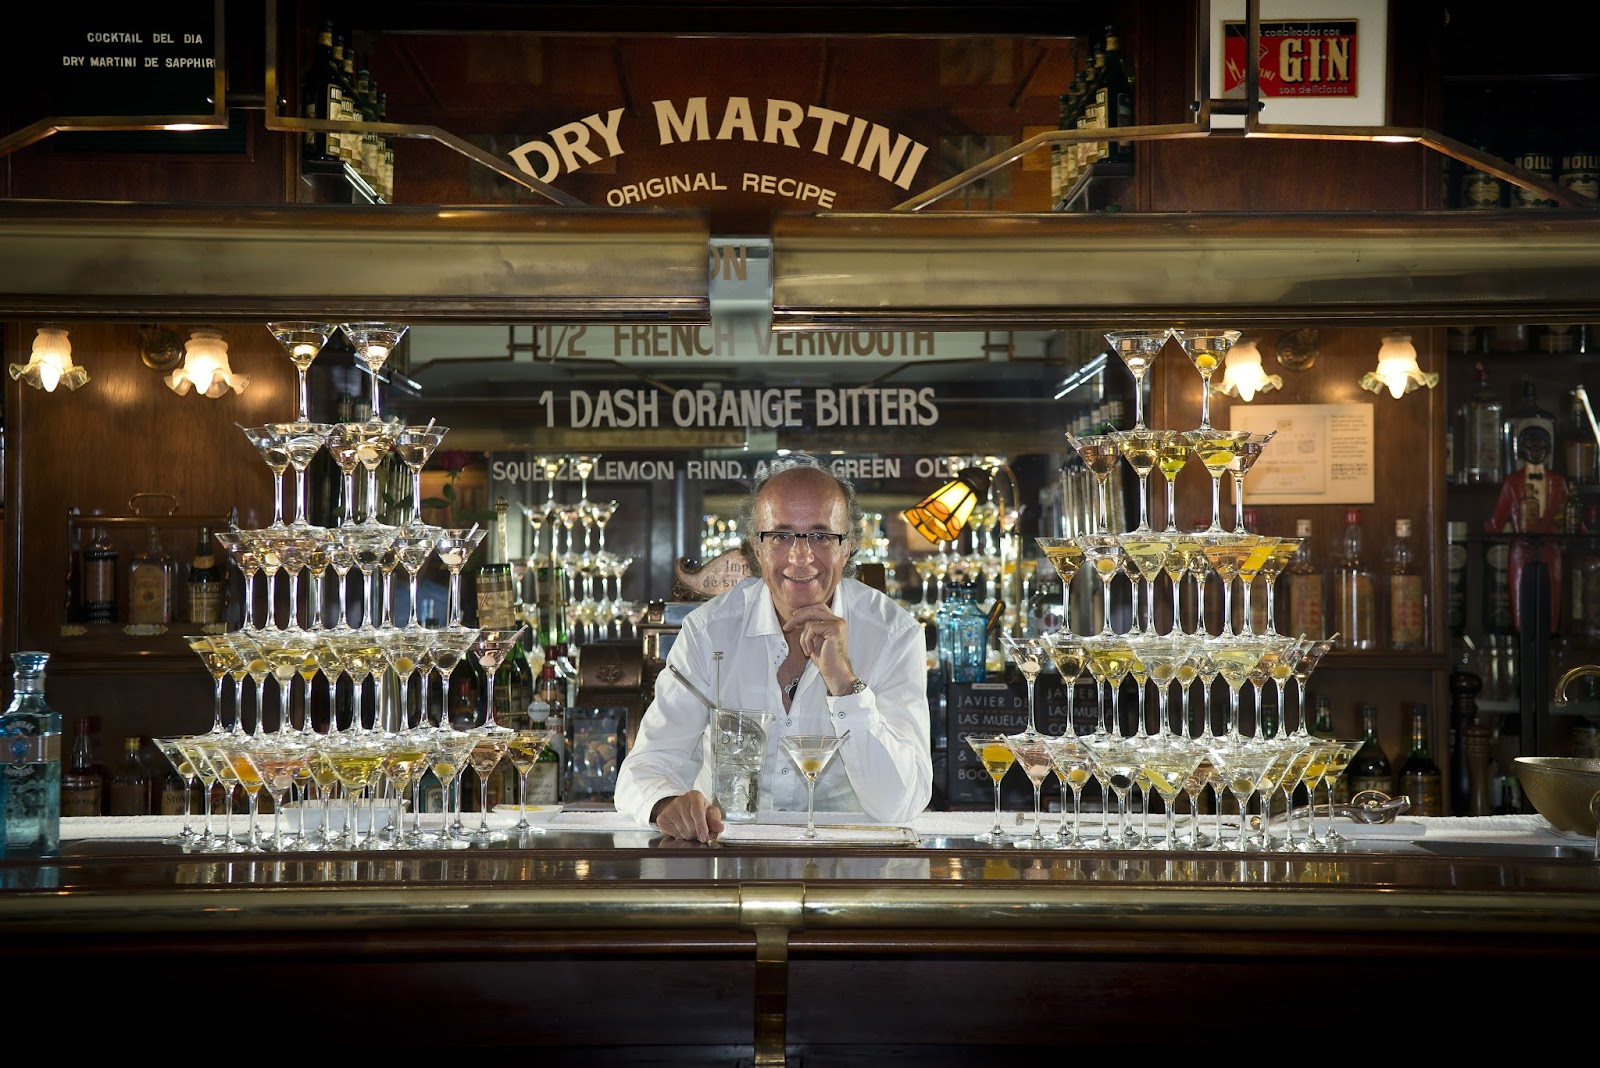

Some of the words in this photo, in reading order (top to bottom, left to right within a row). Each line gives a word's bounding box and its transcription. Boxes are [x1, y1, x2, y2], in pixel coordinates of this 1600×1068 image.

[87, 32, 143, 43] COCKTAIL
[152, 33, 175, 44] DEL
[183, 33, 204, 44] DIA
[62, 55, 85, 67] DRY
[90, 56, 137, 68] MARTINI
[144, 57, 159, 68] DE
[508, 107, 626, 192] DRY
[652, 95, 929, 191] MARTINI
[606, 172, 727, 207] ORIGINAL
[742, 173, 837, 209] RECIPE
[614, 325, 735, 357] FRENCH
[751, 325, 936, 357] VERMOUTH
[538, 390, 555, 428] 1
[570, 389, 659, 428] DASH
[672, 388, 803, 428] ORANGE
[816, 387, 939, 427] BITTERS
[593, 460, 674, 480] LEMON
[831, 458, 901, 479] GREEN
[957, 695, 1005, 708] JAVIER
[958, 713, 979, 725] LAS
[721, 734, 758, 746] DRY
